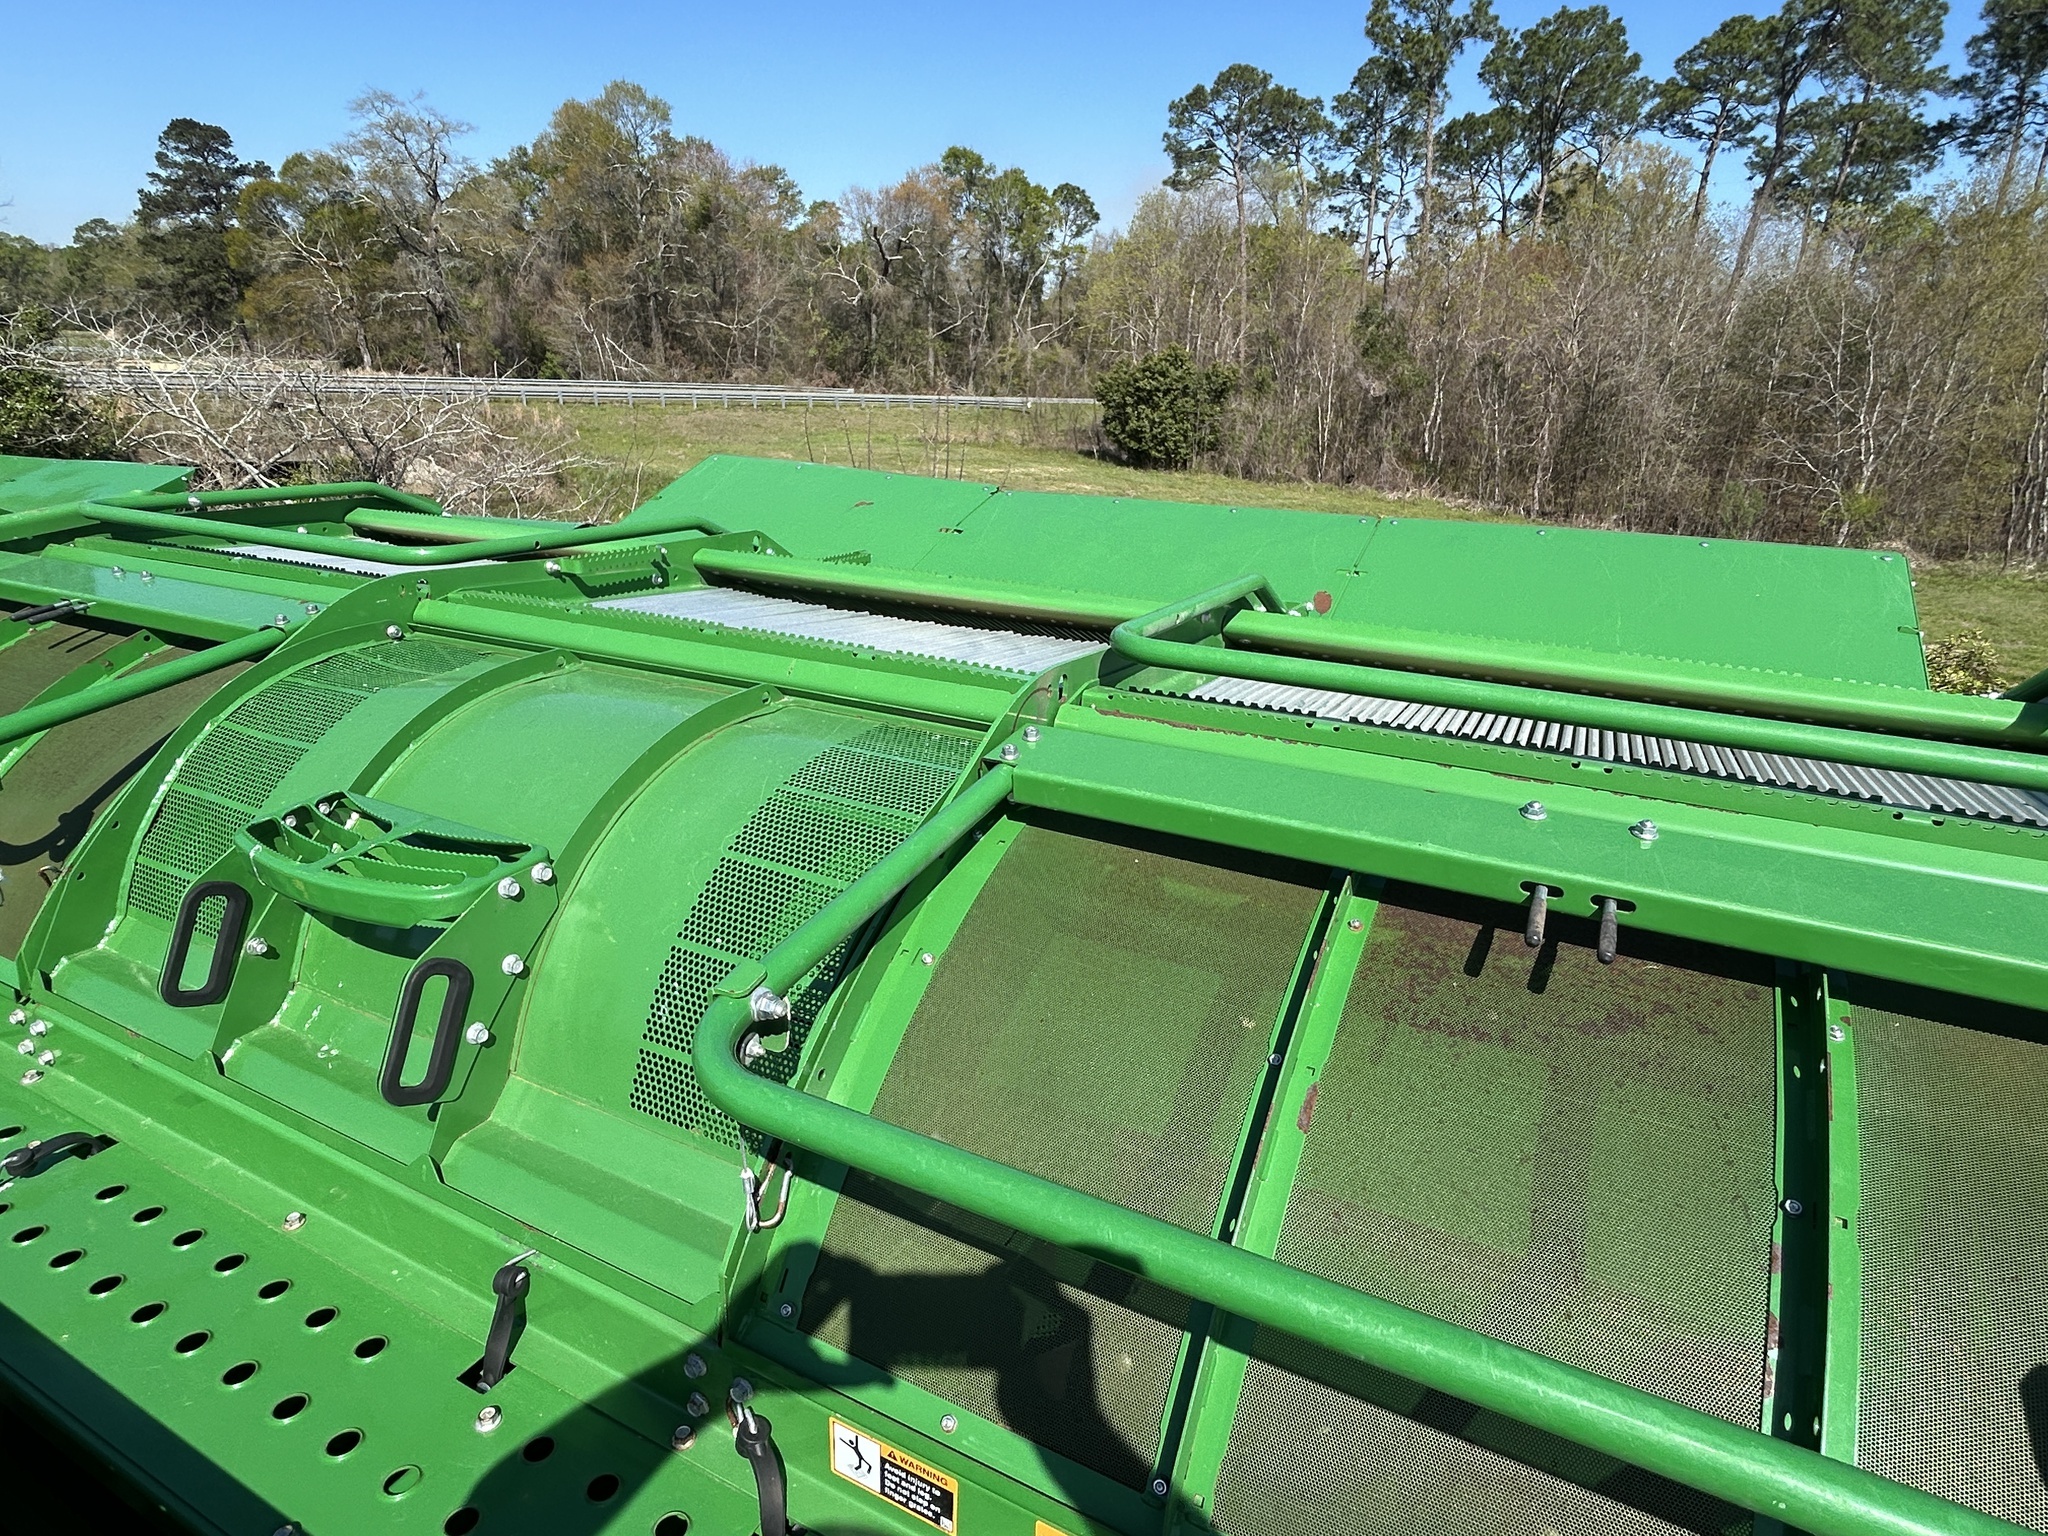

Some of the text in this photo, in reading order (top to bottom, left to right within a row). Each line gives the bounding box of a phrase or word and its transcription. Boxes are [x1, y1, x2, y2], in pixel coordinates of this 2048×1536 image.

[900, 1456, 948, 1486] WARNING
[885, 1478, 896, 1489] Do
[897, 1486, 910, 1497] not
[930, 1504, 940, 1513] on
[901, 1480, 916, 1492] and
[932, 1487, 940, 1496] to
